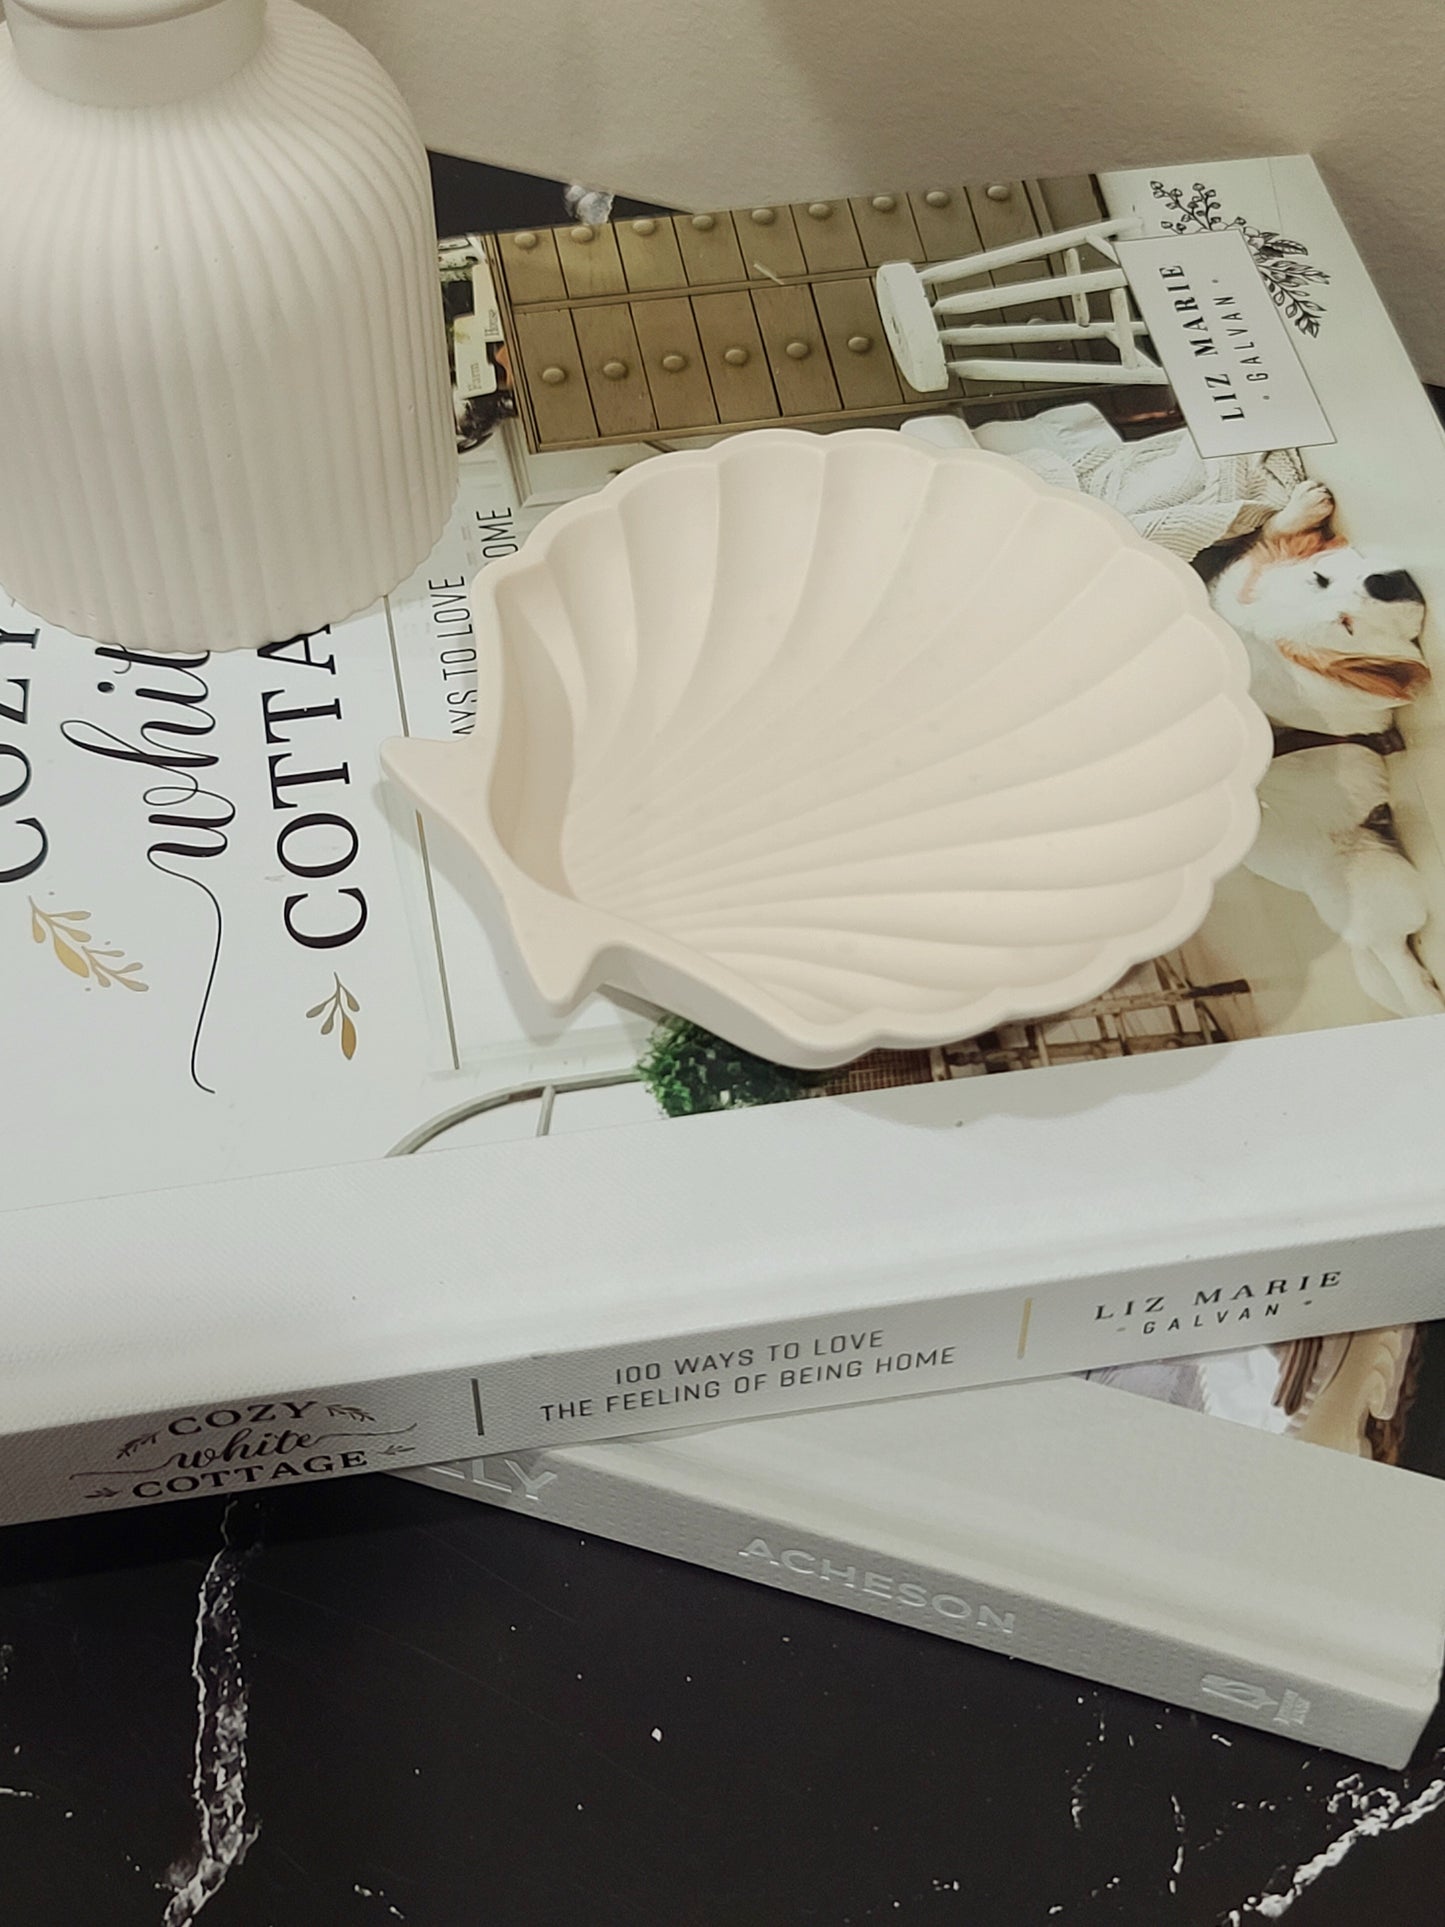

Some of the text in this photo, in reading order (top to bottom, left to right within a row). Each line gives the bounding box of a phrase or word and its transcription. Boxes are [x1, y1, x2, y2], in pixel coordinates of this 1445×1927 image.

[1159, 265, 1245, 421] LIZ MARIE
[1212, 296, 1270, 382] GALVAN
[475, 507, 519, 559] OME
[428, 575, 478, 735] AYS TO LOVE
[60, 643, 236, 900] whit
[257, 624, 368, 949] COTTA
[1094, 1270, 1343, 1320] LIZ MARIE
[1143, 1303, 1280, 1335] GALVAN
[540, 1346, 957, 1422] THE FEELING OF BEING HOME
[615, 1329, 885, 1385] 100 WAYS TO LOVE
[167, 1400, 319, 1436] COZY
[131, 1450, 369, 1498] COTTAGE
[738, 1538, 1016, 1633] ACHESON
